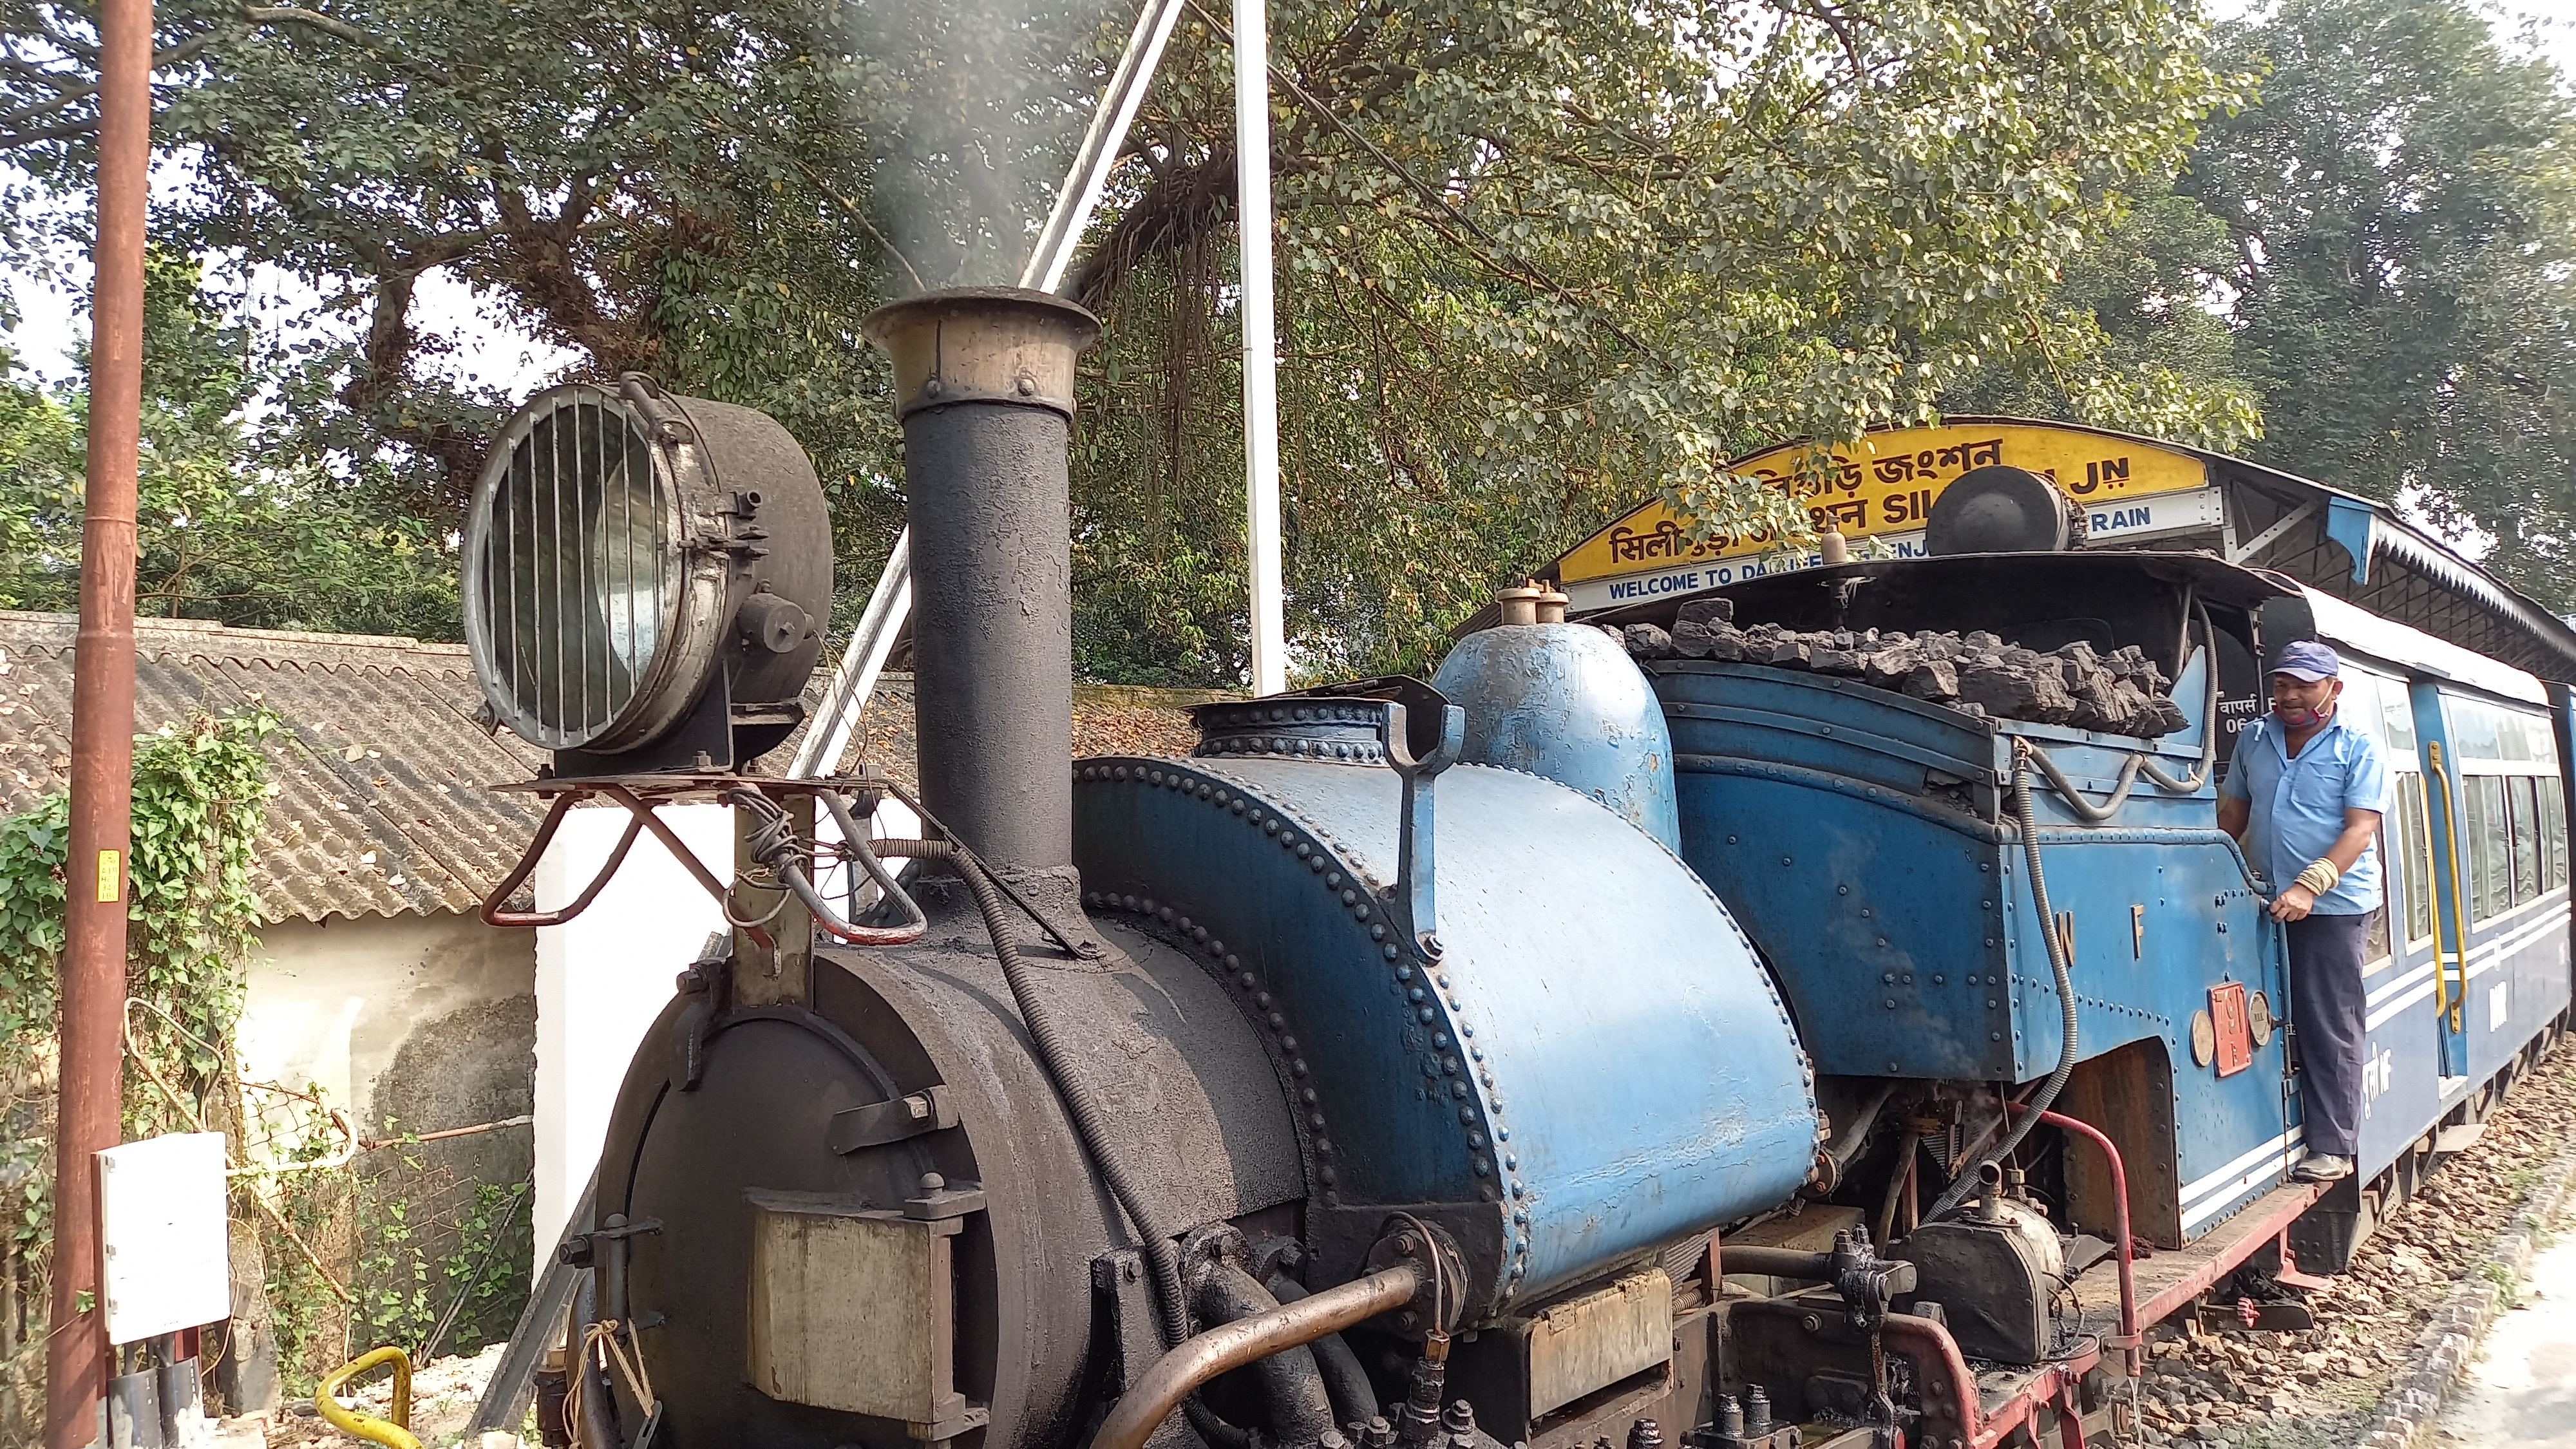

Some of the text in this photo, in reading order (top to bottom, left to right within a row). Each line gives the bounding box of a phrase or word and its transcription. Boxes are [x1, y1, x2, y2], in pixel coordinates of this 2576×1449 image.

[2070, 457, 2130, 495] JN
[1610, 573, 1699, 600] WELCOME
[1705, 568, 1732, 587] TO
[2088, 507, 2151, 532] RAIN
[2130, 904, 2145, 961] F
